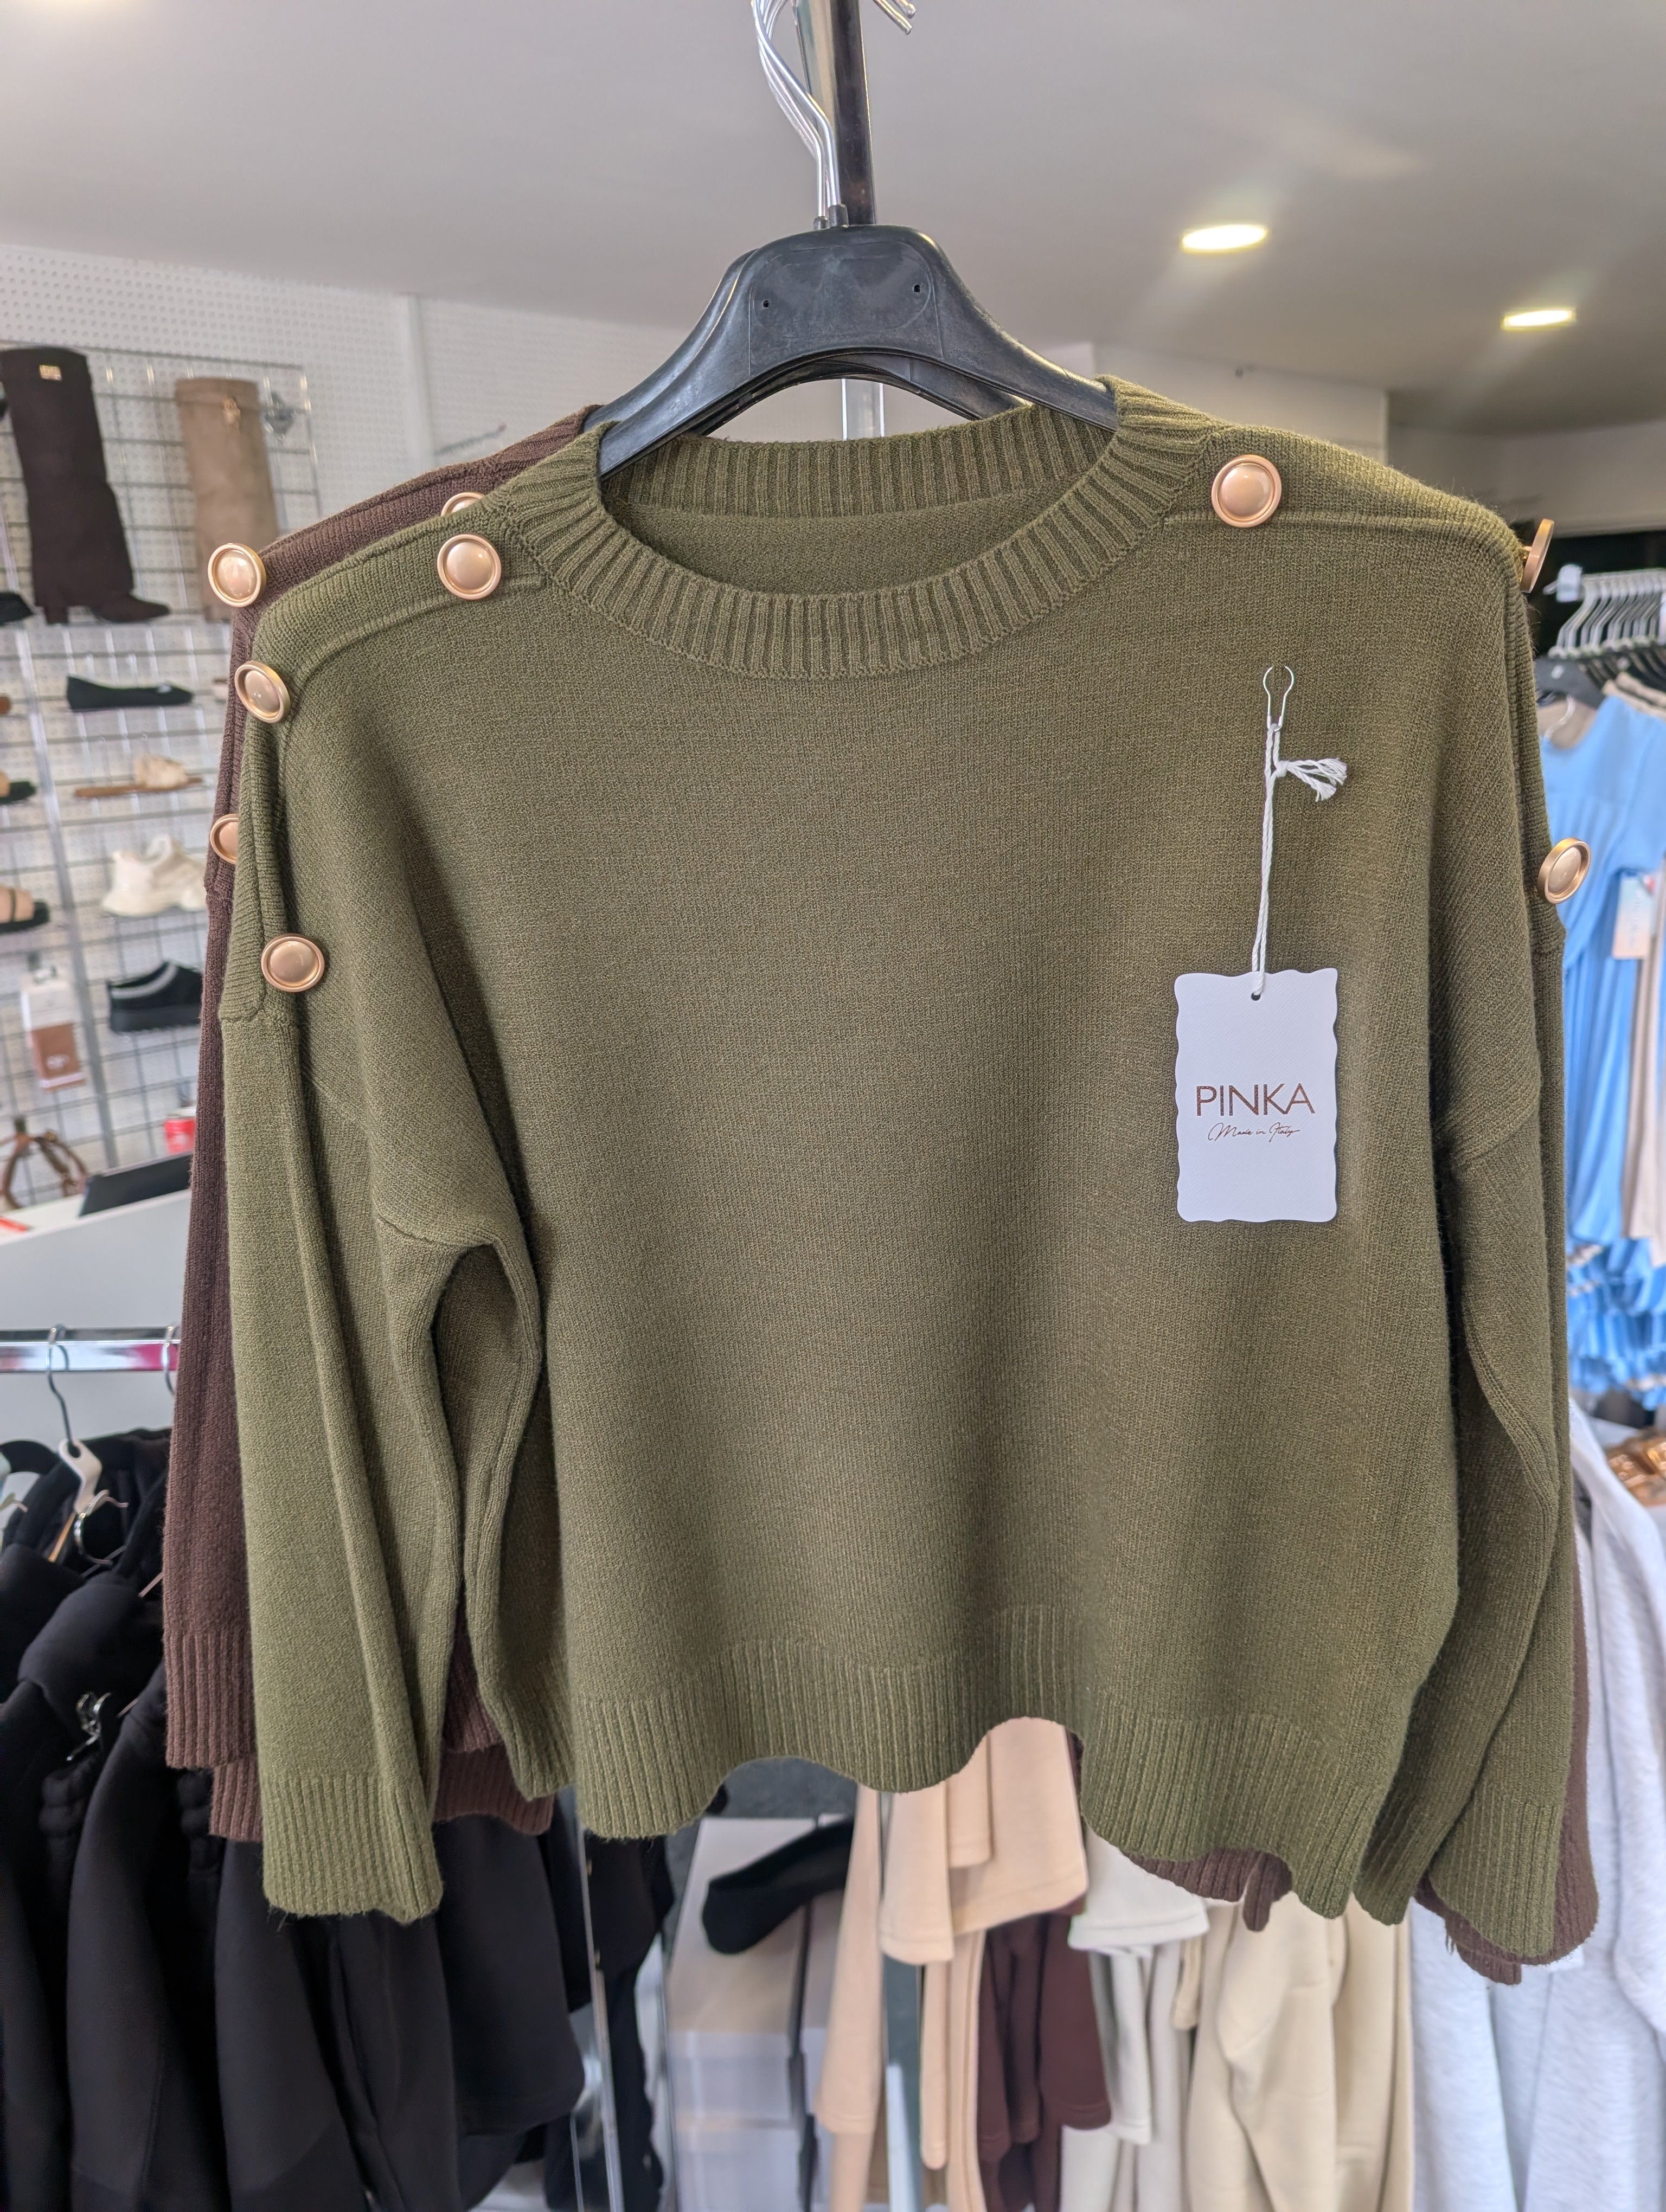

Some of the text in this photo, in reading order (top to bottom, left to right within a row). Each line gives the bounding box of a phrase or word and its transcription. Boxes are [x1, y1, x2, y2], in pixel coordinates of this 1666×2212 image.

[1196, 1083, 1316, 1116] PINKA
[1207, 1122, 1253, 1141] Made
[1268, 1122, 1300, 1142] Italy
